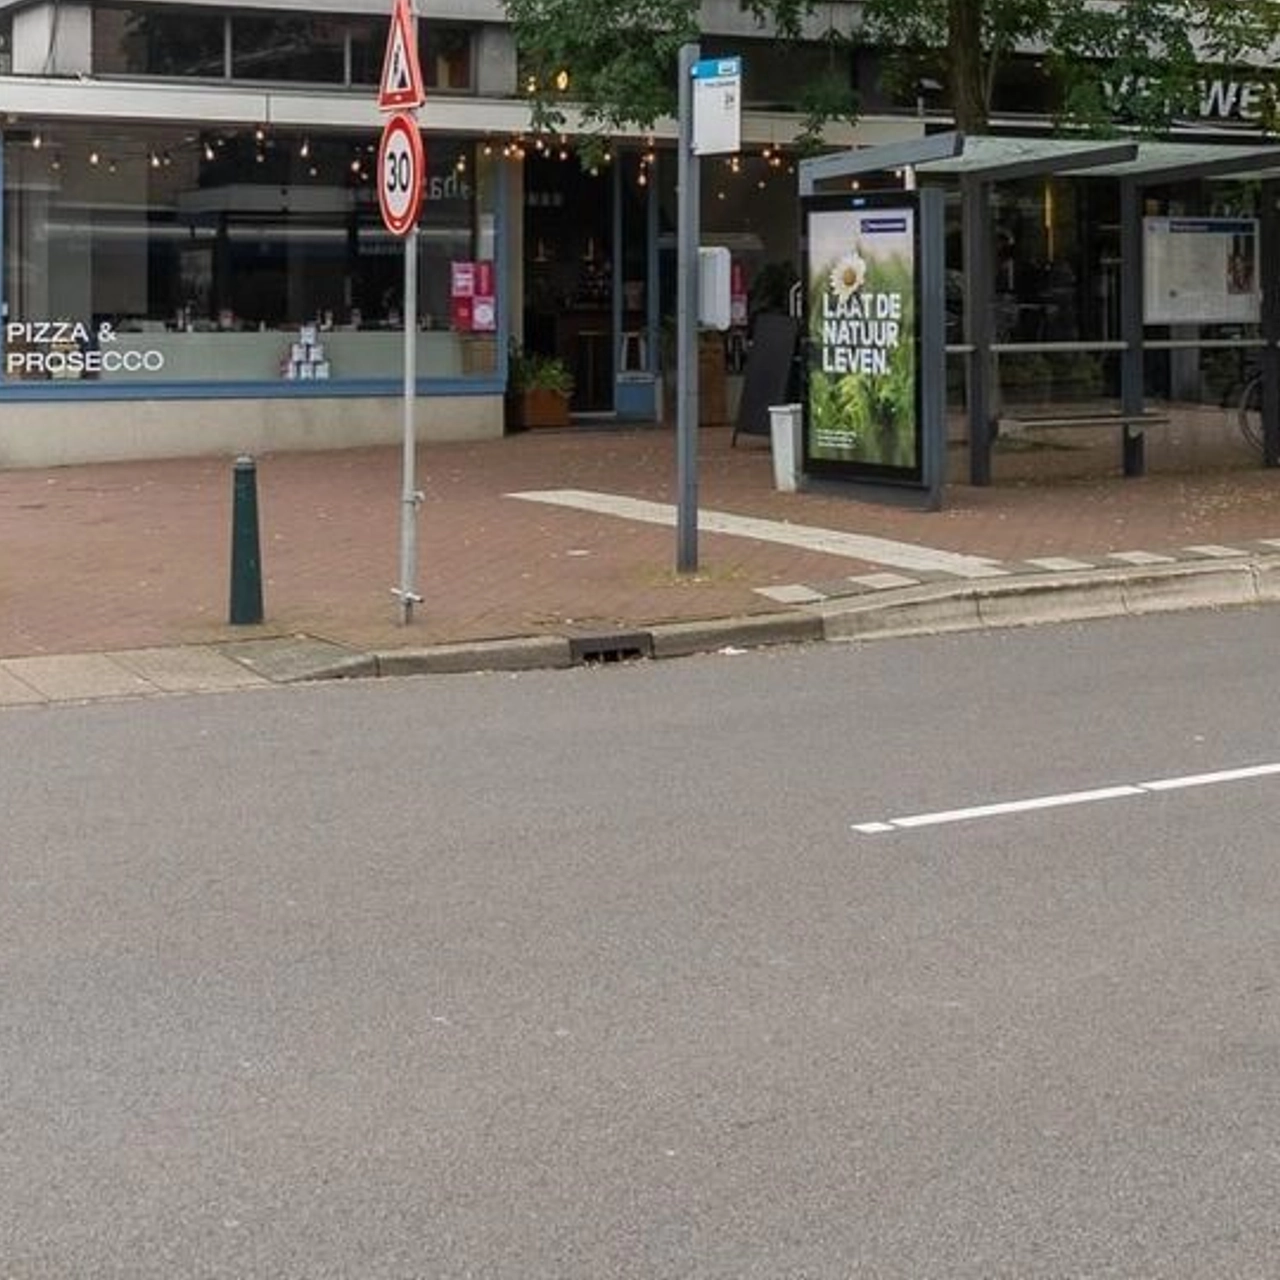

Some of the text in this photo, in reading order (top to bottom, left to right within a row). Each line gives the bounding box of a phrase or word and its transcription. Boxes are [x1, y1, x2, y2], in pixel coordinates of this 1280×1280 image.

[386, 152, 411, 192] 30
[823, 292, 901, 319] LAAT DE
[7, 321, 117, 343] PIZZA &
[822, 320, 899, 347] NATUUR
[7, 350, 165, 372] PROSECCO
[822, 347, 891, 375] LEVEN.
